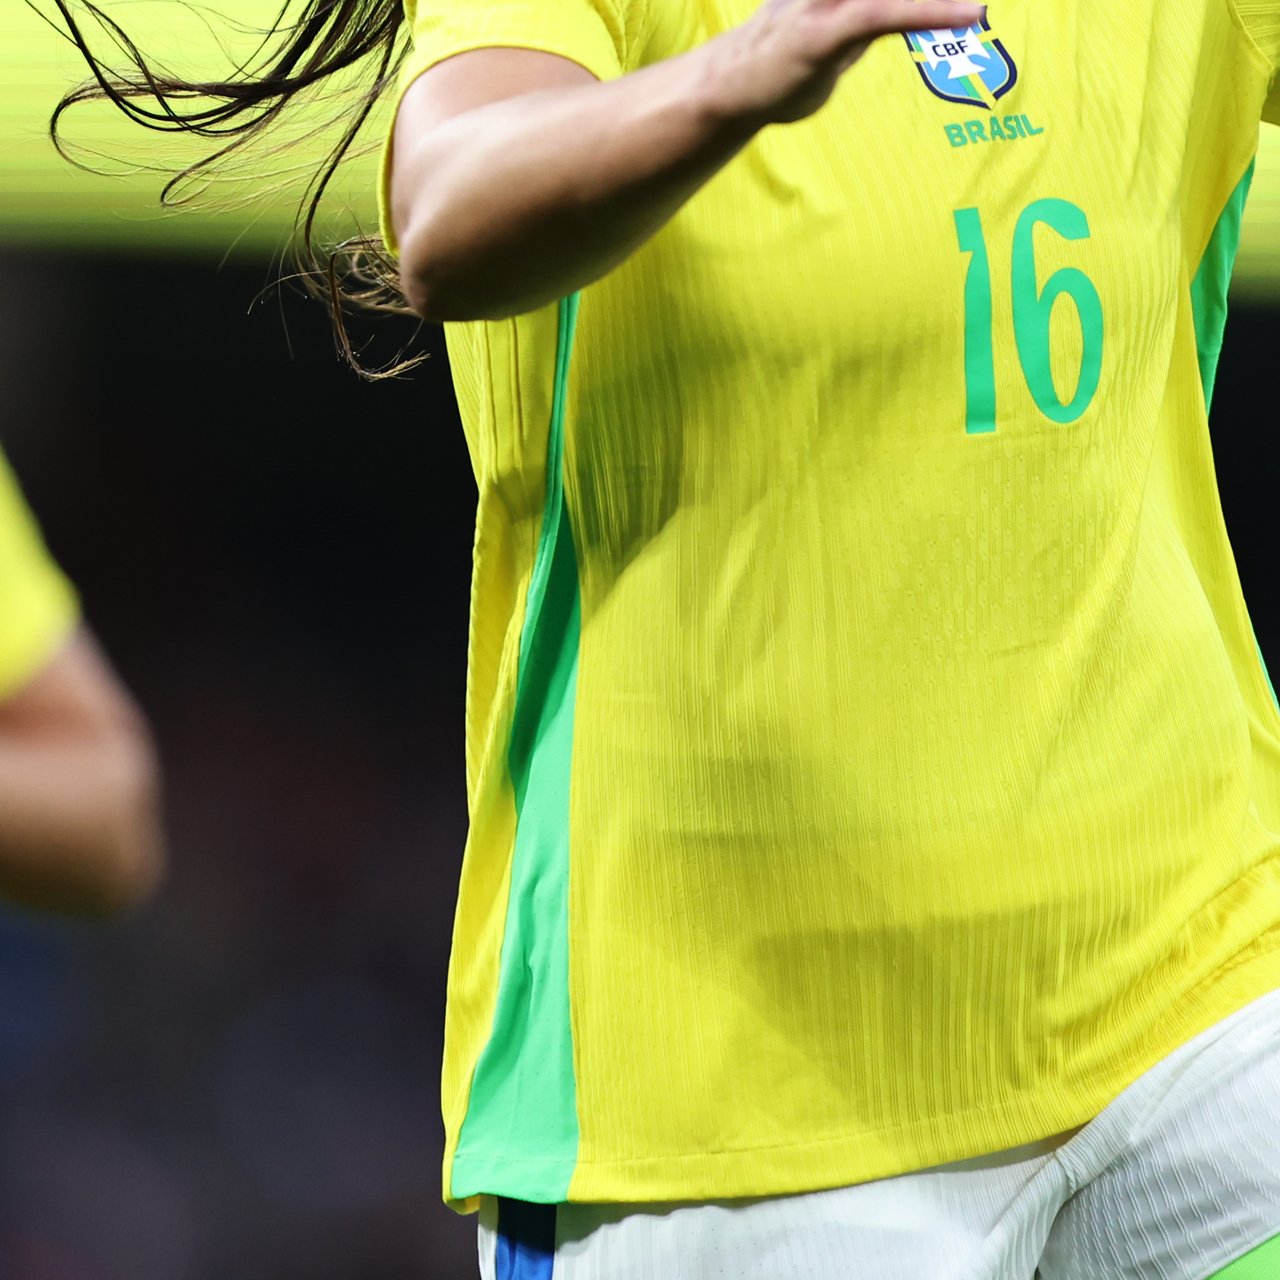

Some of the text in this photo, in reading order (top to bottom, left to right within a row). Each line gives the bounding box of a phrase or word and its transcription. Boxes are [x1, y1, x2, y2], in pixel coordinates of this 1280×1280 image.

[931, 39, 969, 58] CBF
[943, 113, 1044, 148] BRASIL
[952, 197, 1105, 435] 16
